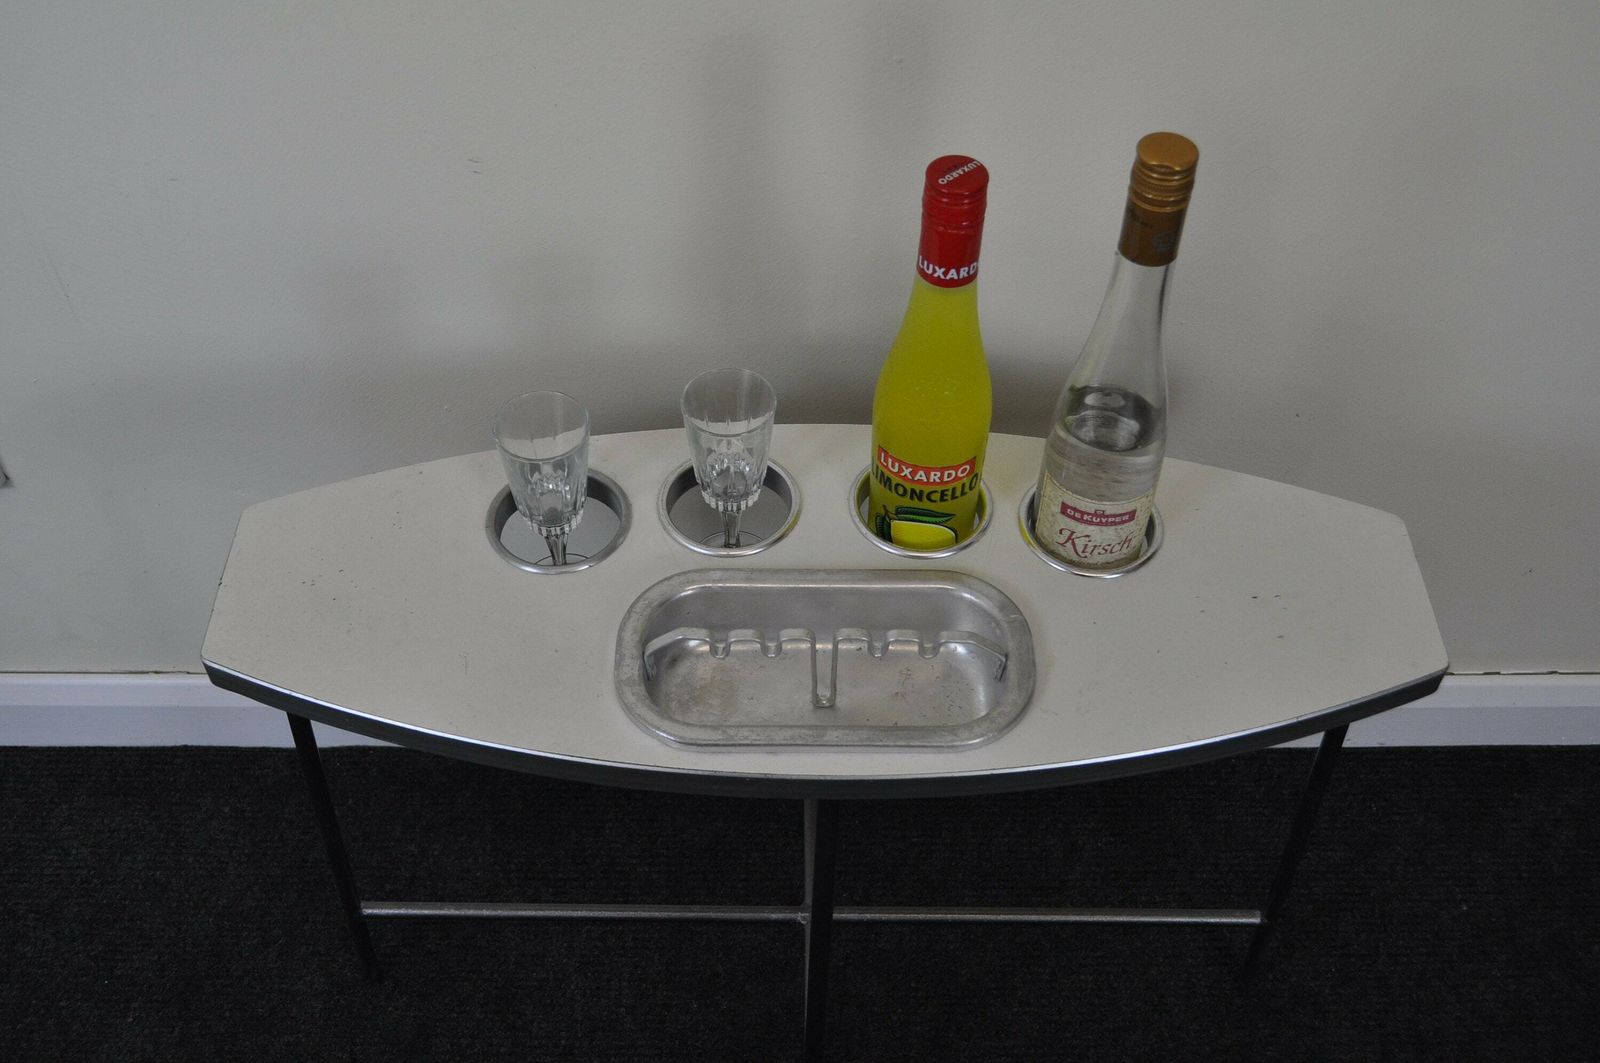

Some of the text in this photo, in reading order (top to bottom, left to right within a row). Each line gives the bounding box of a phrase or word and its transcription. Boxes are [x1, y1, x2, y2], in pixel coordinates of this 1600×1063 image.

[938, 160, 983, 186] LUXARDO
[918, 255, 979, 280] LUXARD
[880, 451, 970, 483] LUXARDO
[1056, 528, 1134, 558] Kirsch
